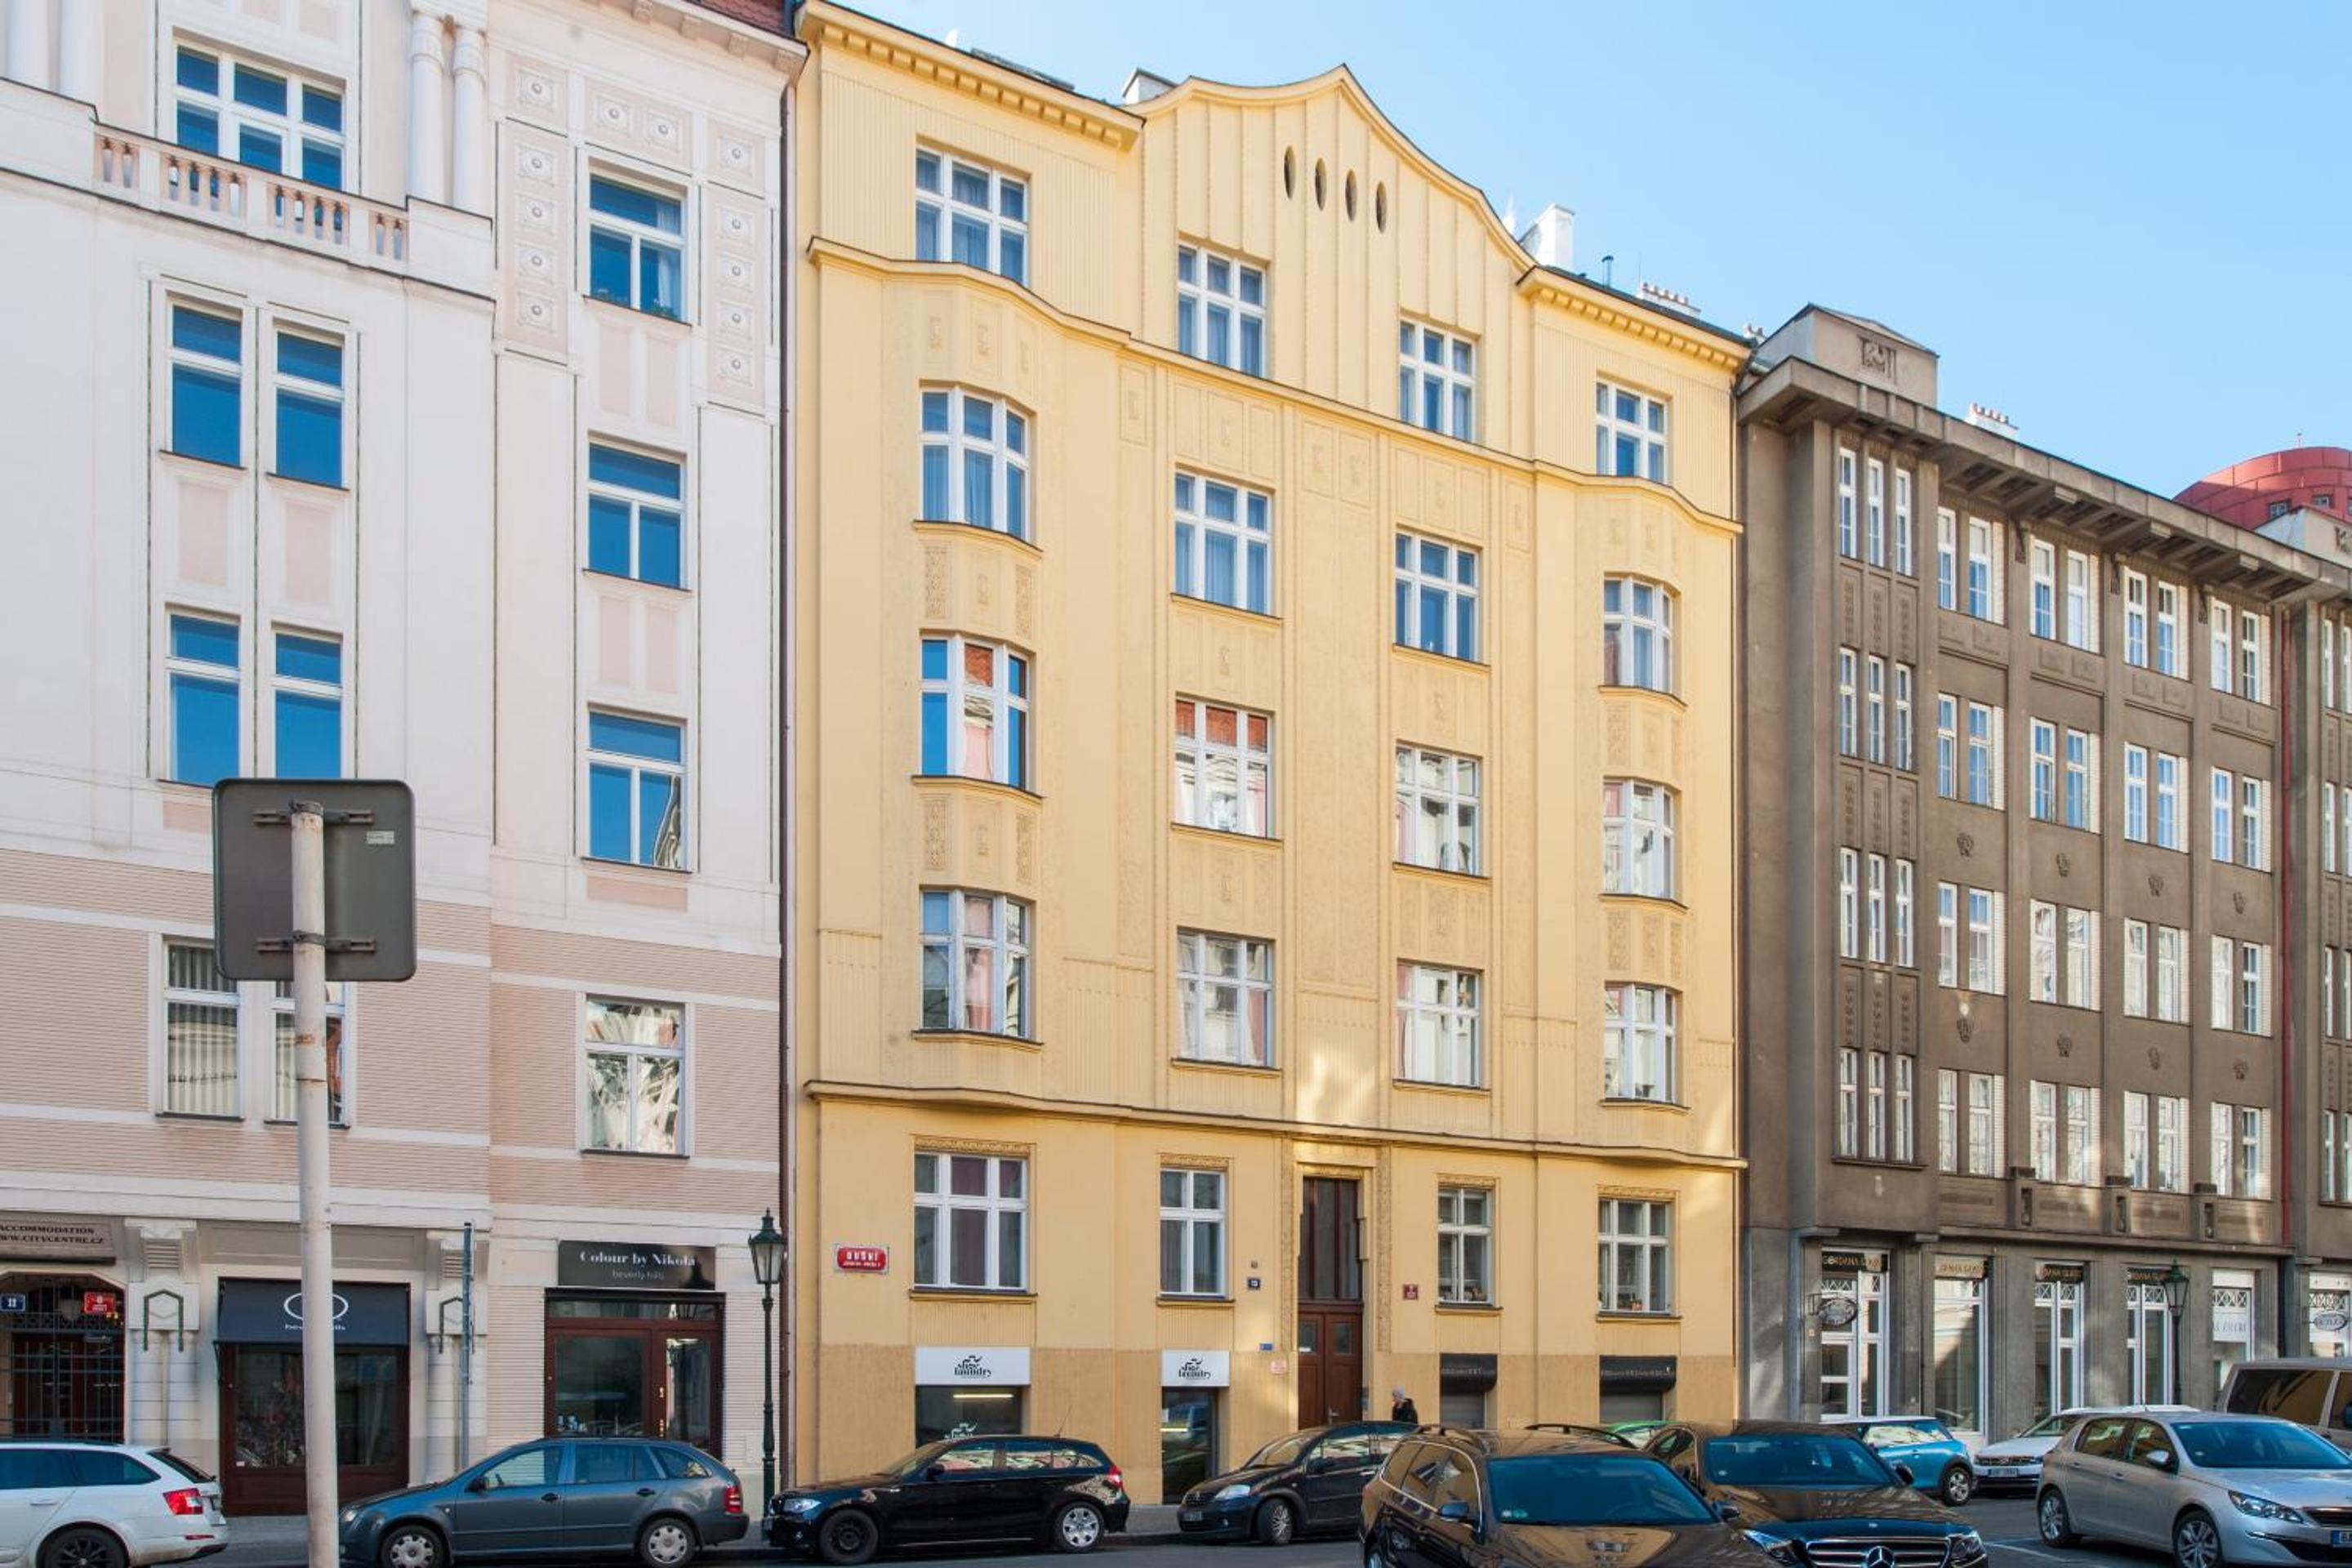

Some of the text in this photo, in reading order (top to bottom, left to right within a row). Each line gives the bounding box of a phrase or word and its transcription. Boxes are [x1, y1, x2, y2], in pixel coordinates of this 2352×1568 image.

[0, 1225, 95, 1234] ACCOMMODATION
[579, 1251, 696, 1267] Colour by Nikola
